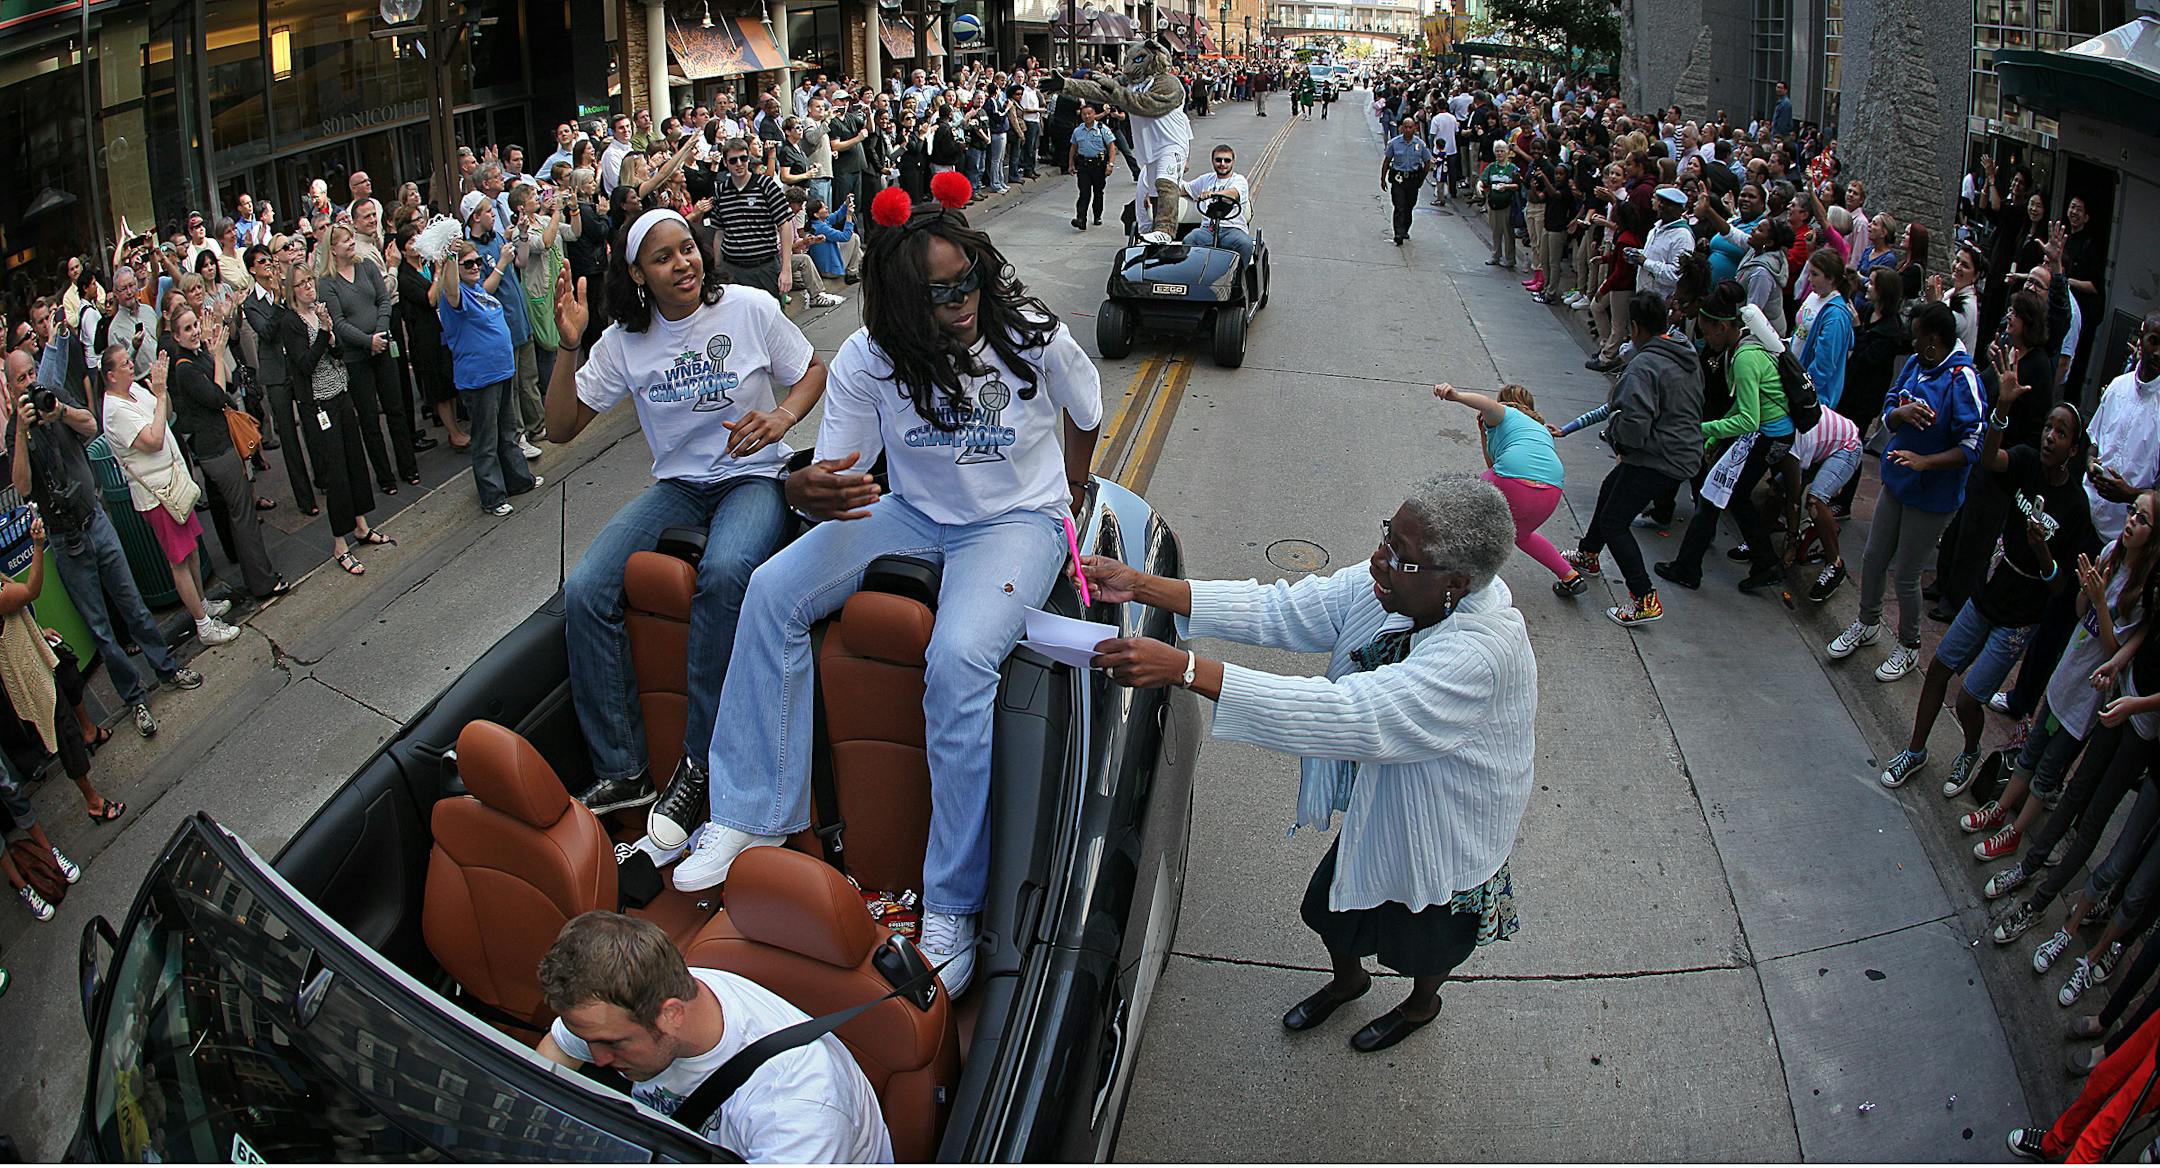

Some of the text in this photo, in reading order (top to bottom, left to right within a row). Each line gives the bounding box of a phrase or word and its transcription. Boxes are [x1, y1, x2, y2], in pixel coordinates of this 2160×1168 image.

[322, 115, 346, 137] 801
[664, 360, 712, 382] WNBA
[649, 372, 739, 402] CHAMPIONS
[904, 424, 1016, 448] CHAMPIONS
